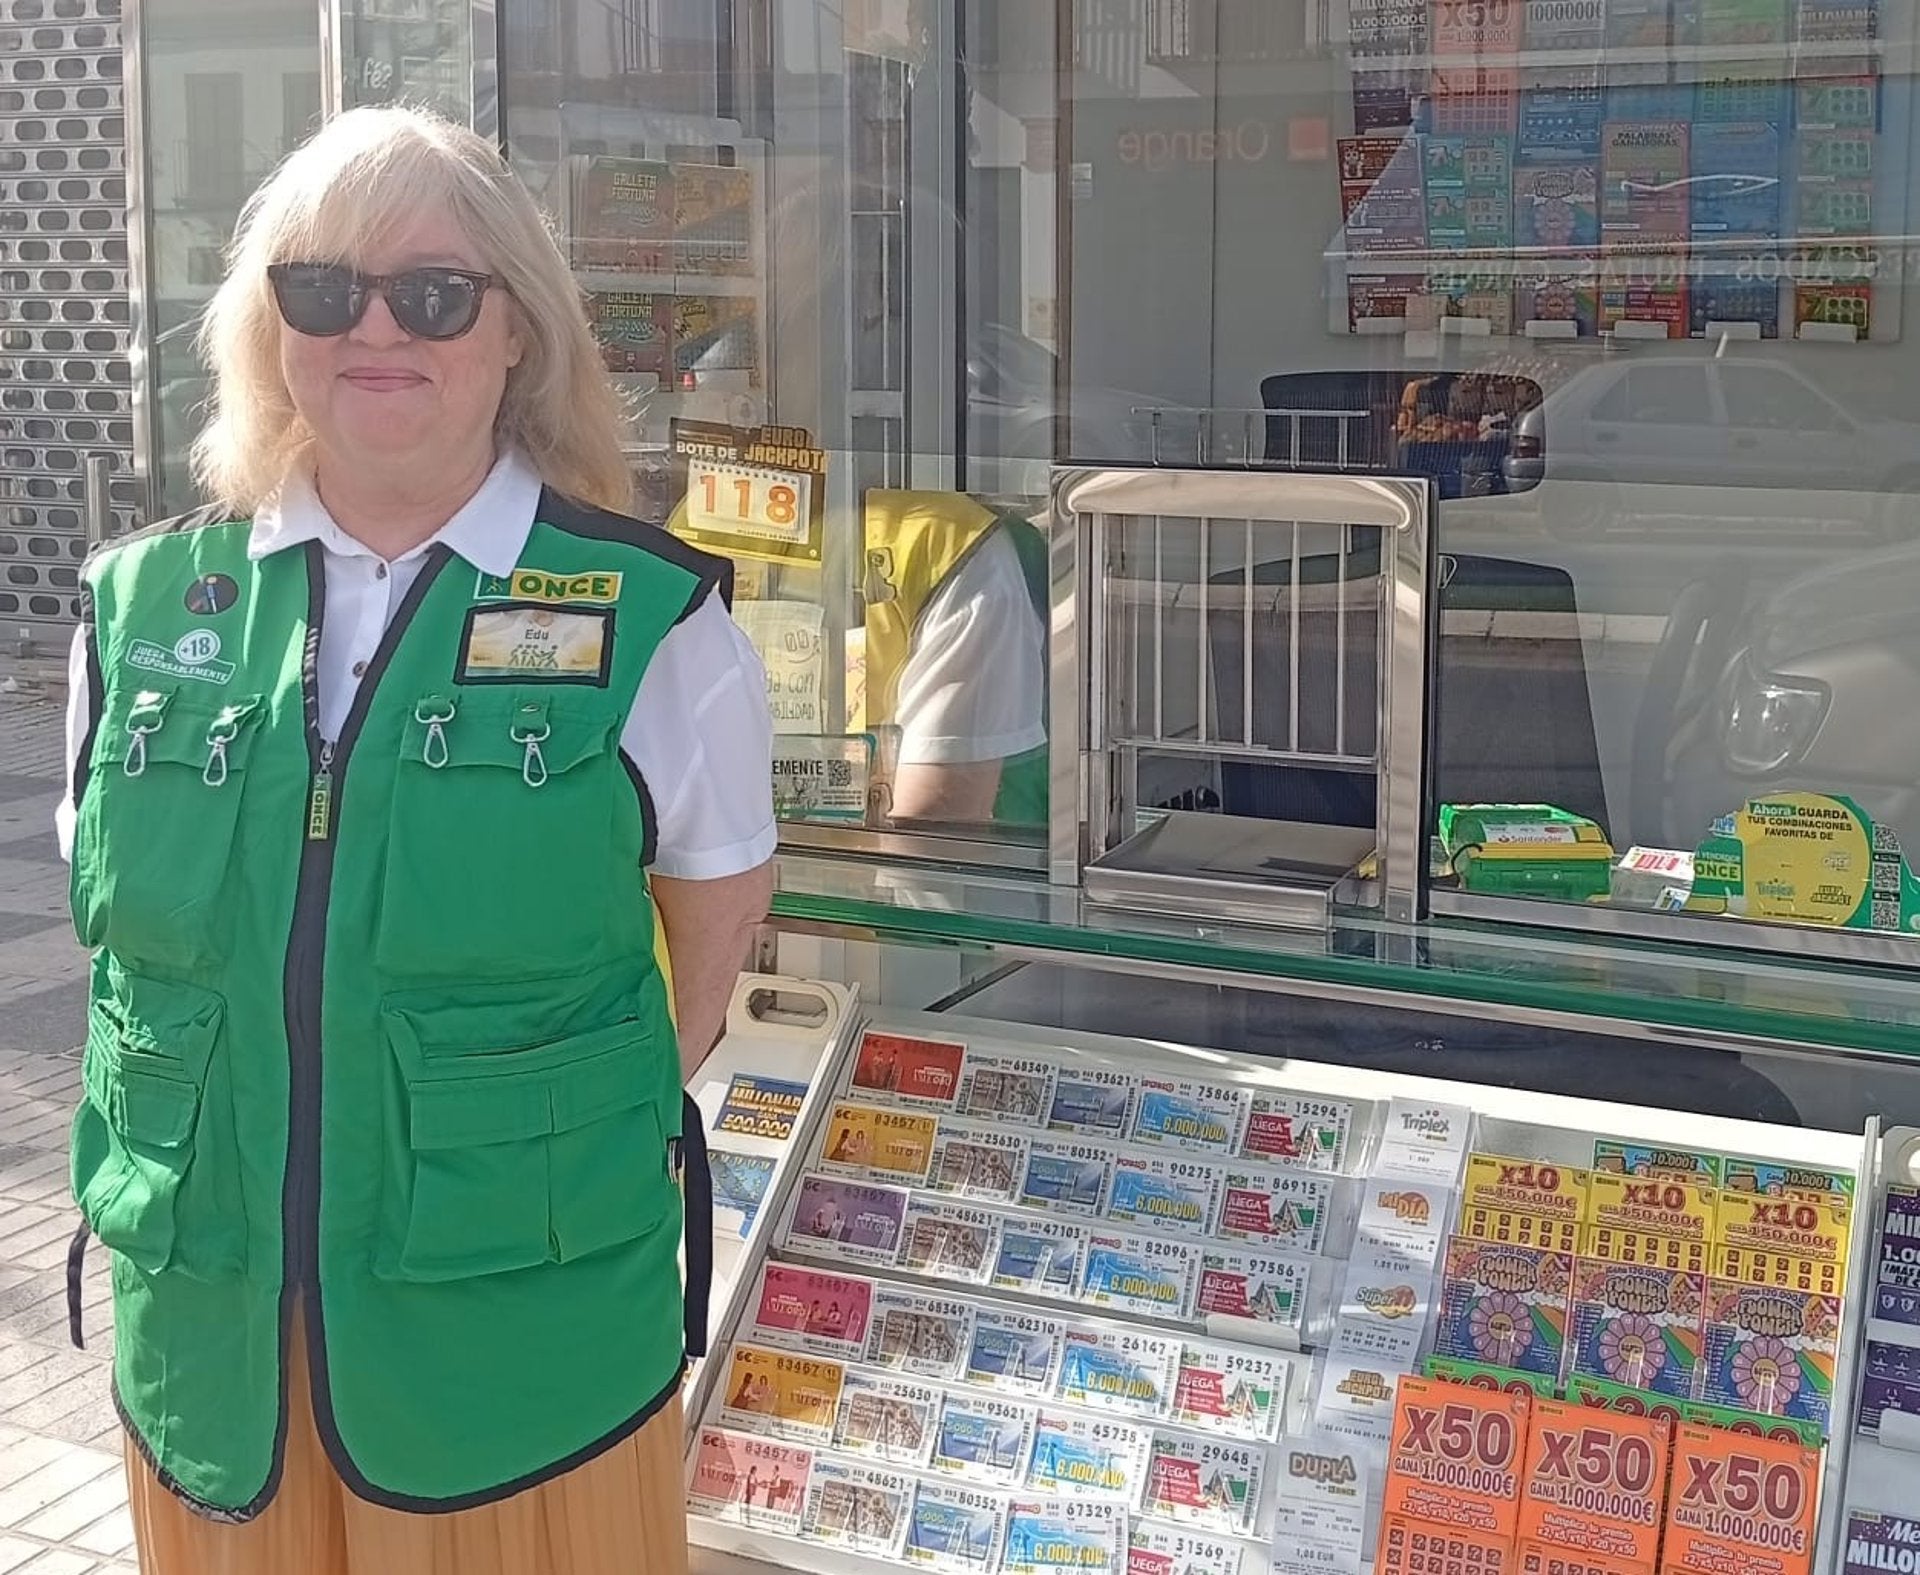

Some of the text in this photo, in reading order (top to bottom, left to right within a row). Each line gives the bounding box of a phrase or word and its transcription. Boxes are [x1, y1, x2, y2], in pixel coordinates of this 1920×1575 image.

[613, 172, 657, 188] GALLETA
[676, 440, 823, 472] BOTE DE JACKPOT
[699, 474, 796, 524] 118
[518, 575, 611, 597] ONCE
[524, 628, 549, 641] Edu
[181, 636, 211, 657] +18
[131, 654, 228, 682] RESPONSABLEMENTE
[311, 792, 325, 834] ONCE
[1752, 803, 1849, 820] Ahora GUARDA
[1747, 815, 1853, 831] TUS COMBINACIONES
[1764, 829, 1834, 841] FAVORITAS DE
[1695, 863, 1739, 879] ONCE
[1095, 1070, 1132, 1087] 93621
[1198, 1085, 1240, 1102] 75864
[1295, 1101, 1338, 1118] 15294
[721, 1113, 792, 1139] 500.000
[984, 1133, 1021, 1149] 25630
[1070, 1146, 1107, 1162] 80352
[1651, 1151, 1698, 1170] 10.000€
[1169, 1162, 1212, 1179] 90275
[1784, 1169, 1833, 1189] 10.000€
[1272, 1176, 1317, 1194] 86915
[1496, 1187, 1578, 1210] 150.000€
[1622, 1207, 1705, 1230] 150.000€
[1043, 1222, 1081, 1240] 47103
[1747, 1225, 1838, 1250] 150.000€
[1144, 1240, 1187, 1258] 82096
[1249, 1259, 1294, 1277] 97586
[1017, 1317, 1056, 1335] 62310
[1122, 1336, 1167, 1355] 26147
[1226, 1355, 1272, 1375] 59237
[894, 1383, 932, 1401] 25630
[987, 1401, 1026, 1420] 93621
[1202, 1444, 1249, 1465] 29648
[1289, 1451, 1357, 1484] DUPLA
[1394, 1456, 1514, 1496] GANA 1.000.000€
[866, 1471, 906, 1491] 48621
[1530, 1480, 1654, 1522] GANA 1.000.000€
[1066, 1504, 1112, 1519] 67329
[1674, 1508, 1804, 1551] GANA 1.000.000€
[1176, 1537, 1224, 1560] 31569
